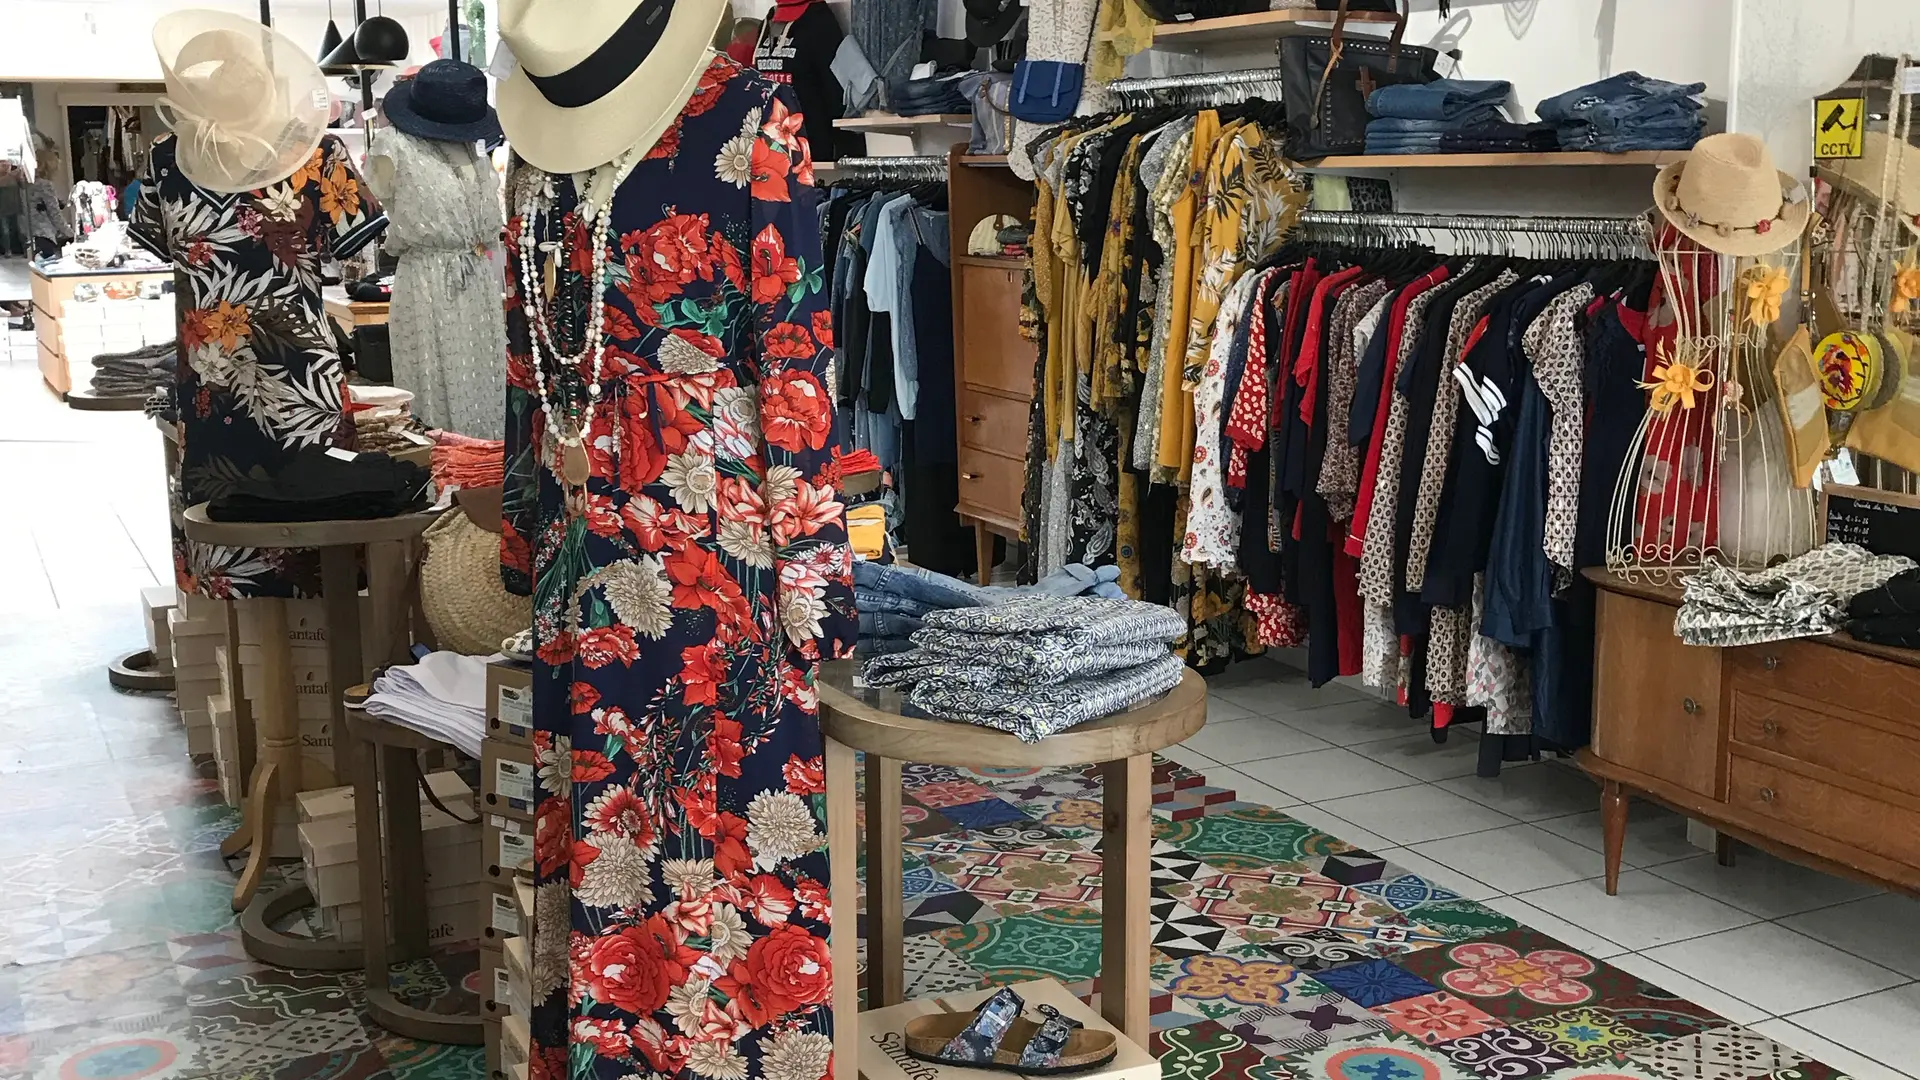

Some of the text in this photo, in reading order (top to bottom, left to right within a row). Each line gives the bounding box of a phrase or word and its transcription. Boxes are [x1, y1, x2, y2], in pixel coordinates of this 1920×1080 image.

[1820, 143, 1856, 156] CCTV
[289, 628, 326, 641] antaf
[295, 682, 330, 694] antaf
[302, 734, 334, 747] Sant
